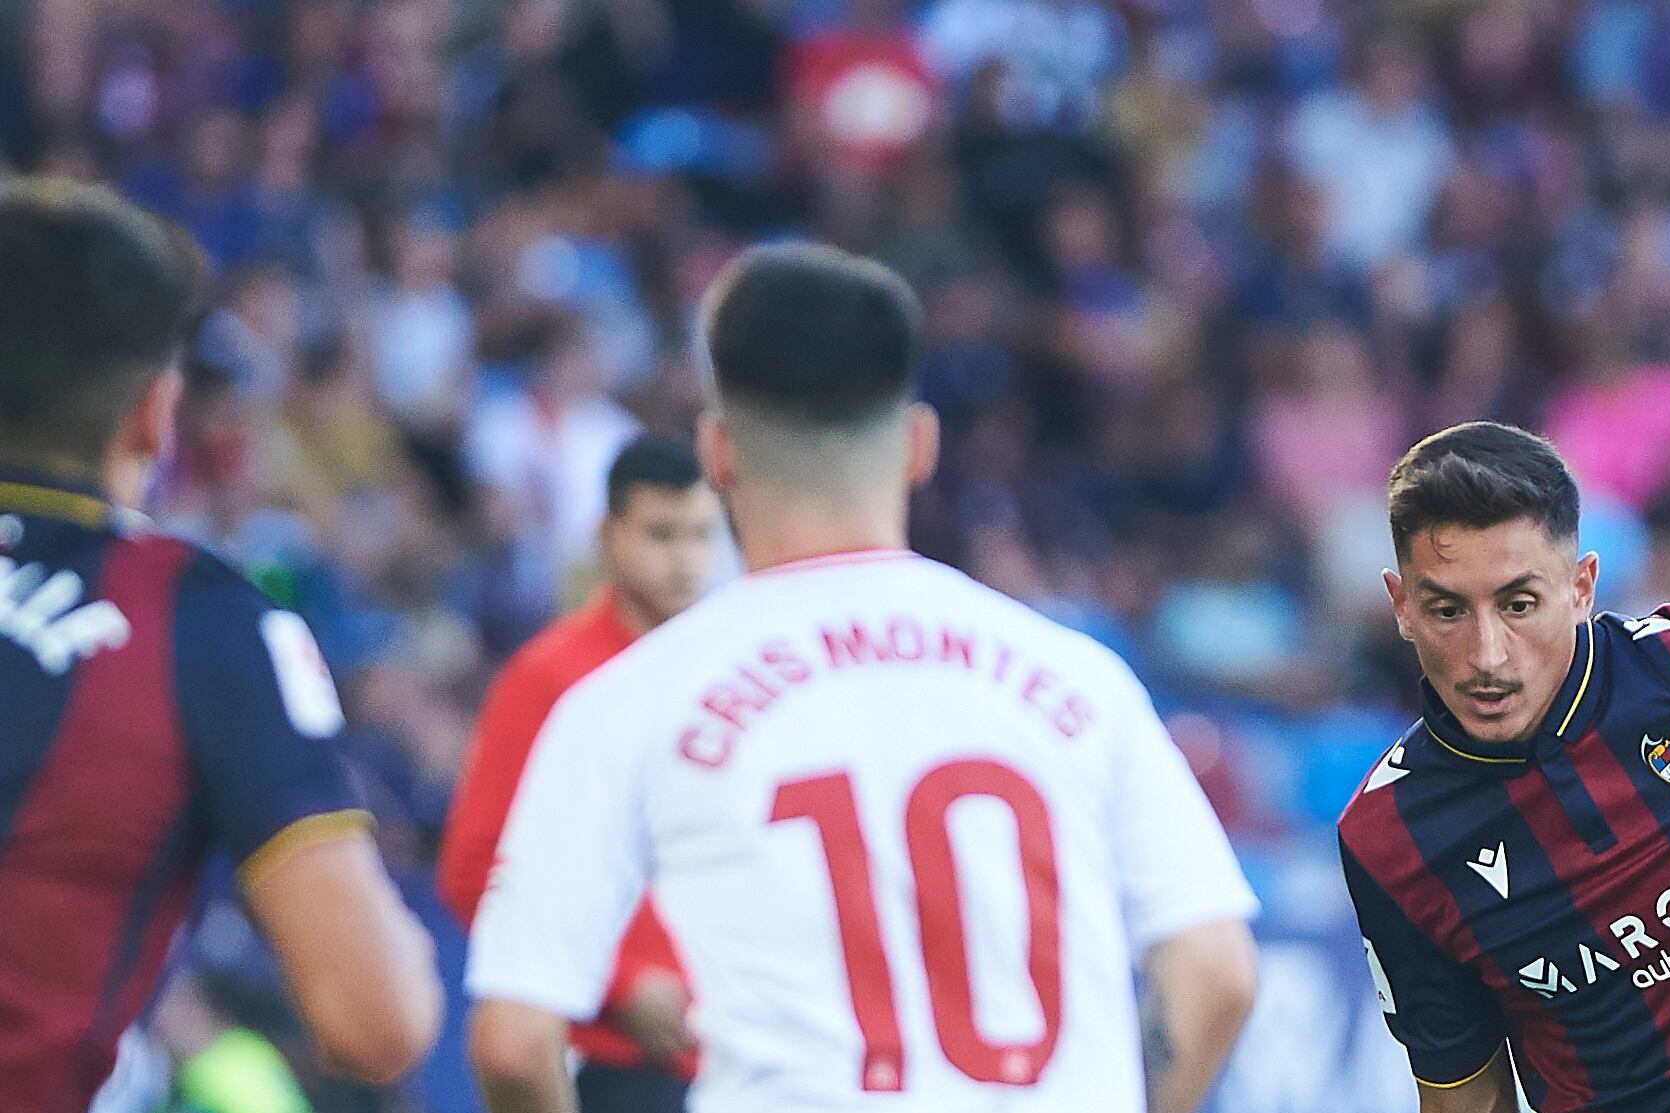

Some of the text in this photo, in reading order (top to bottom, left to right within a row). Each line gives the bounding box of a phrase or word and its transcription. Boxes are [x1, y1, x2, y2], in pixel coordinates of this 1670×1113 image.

[676, 618, 1096, 770] CRIS MONTES
[768, 752, 1063, 1094] 10
